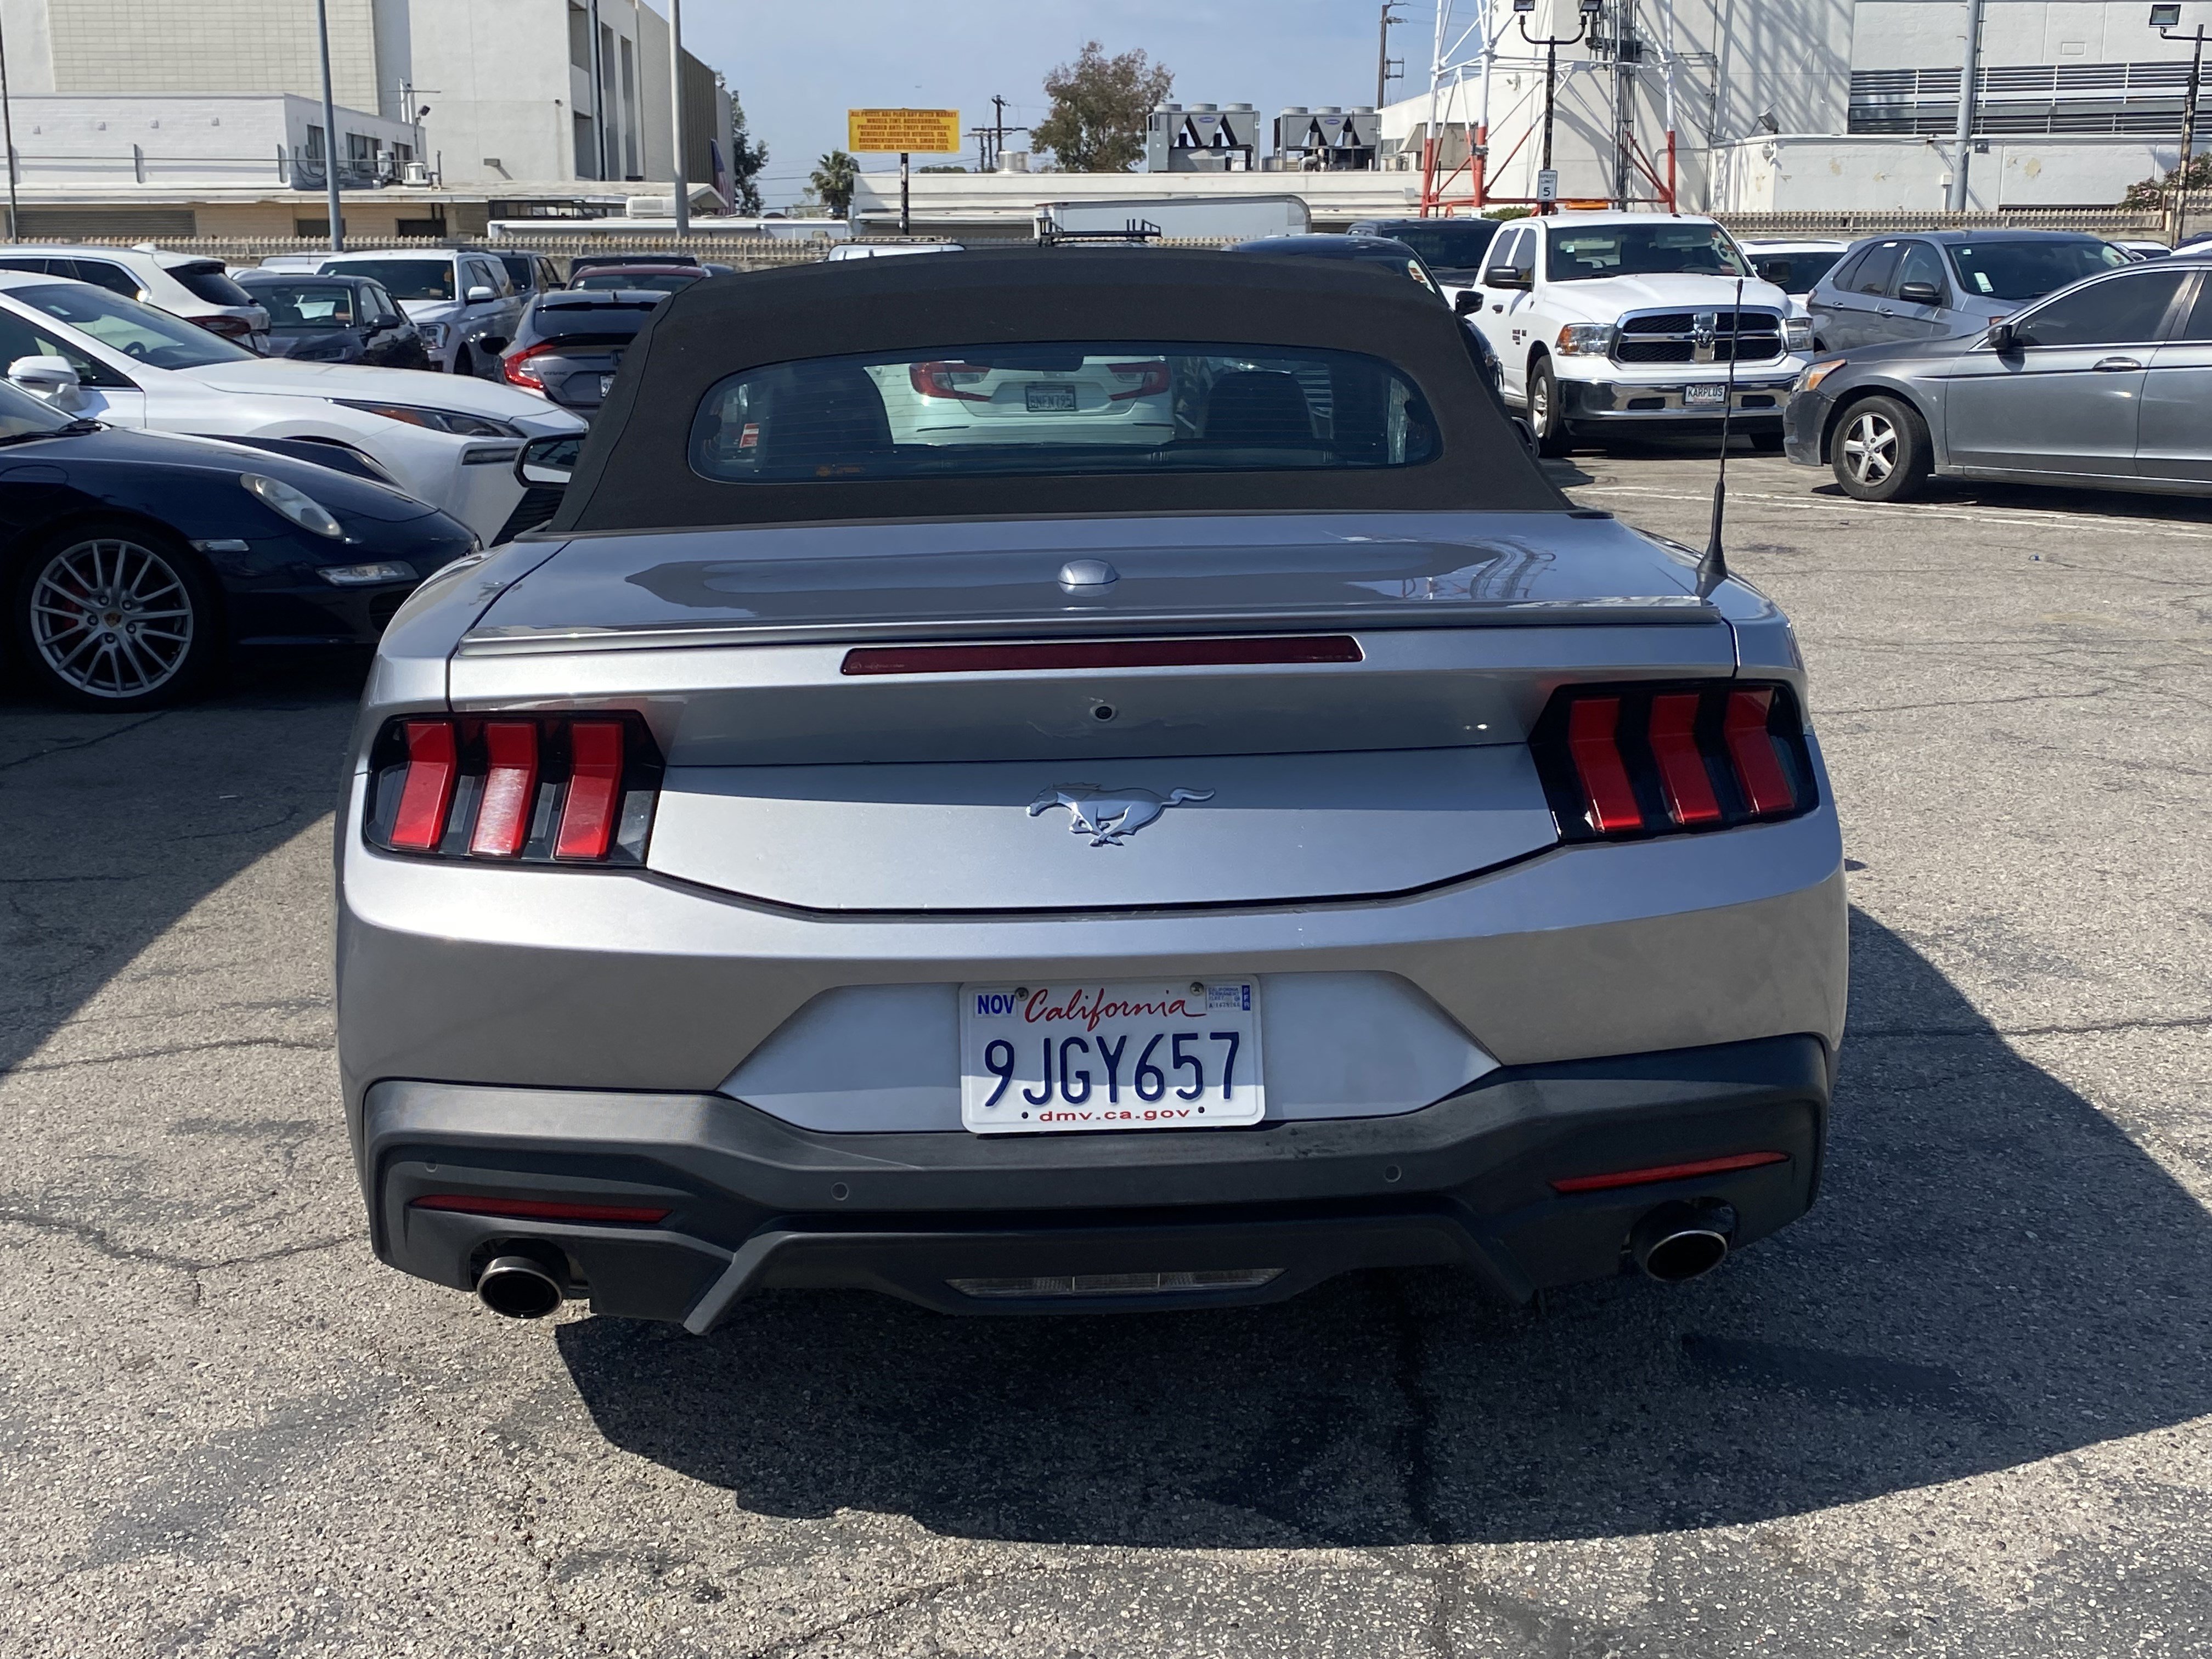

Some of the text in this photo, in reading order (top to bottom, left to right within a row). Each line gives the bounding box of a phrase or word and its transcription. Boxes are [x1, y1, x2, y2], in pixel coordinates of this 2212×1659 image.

[1543, 187, 1550, 196] 5
[1688, 387, 1723, 397] KARPLUS
[977, 994, 1015, 1015] NOV
[1024, 988, 1207, 1032] California
[984, 1031, 1240, 1107] 9JGY657
[1039, 1108, 1191, 1122] dmv.ca.gov
